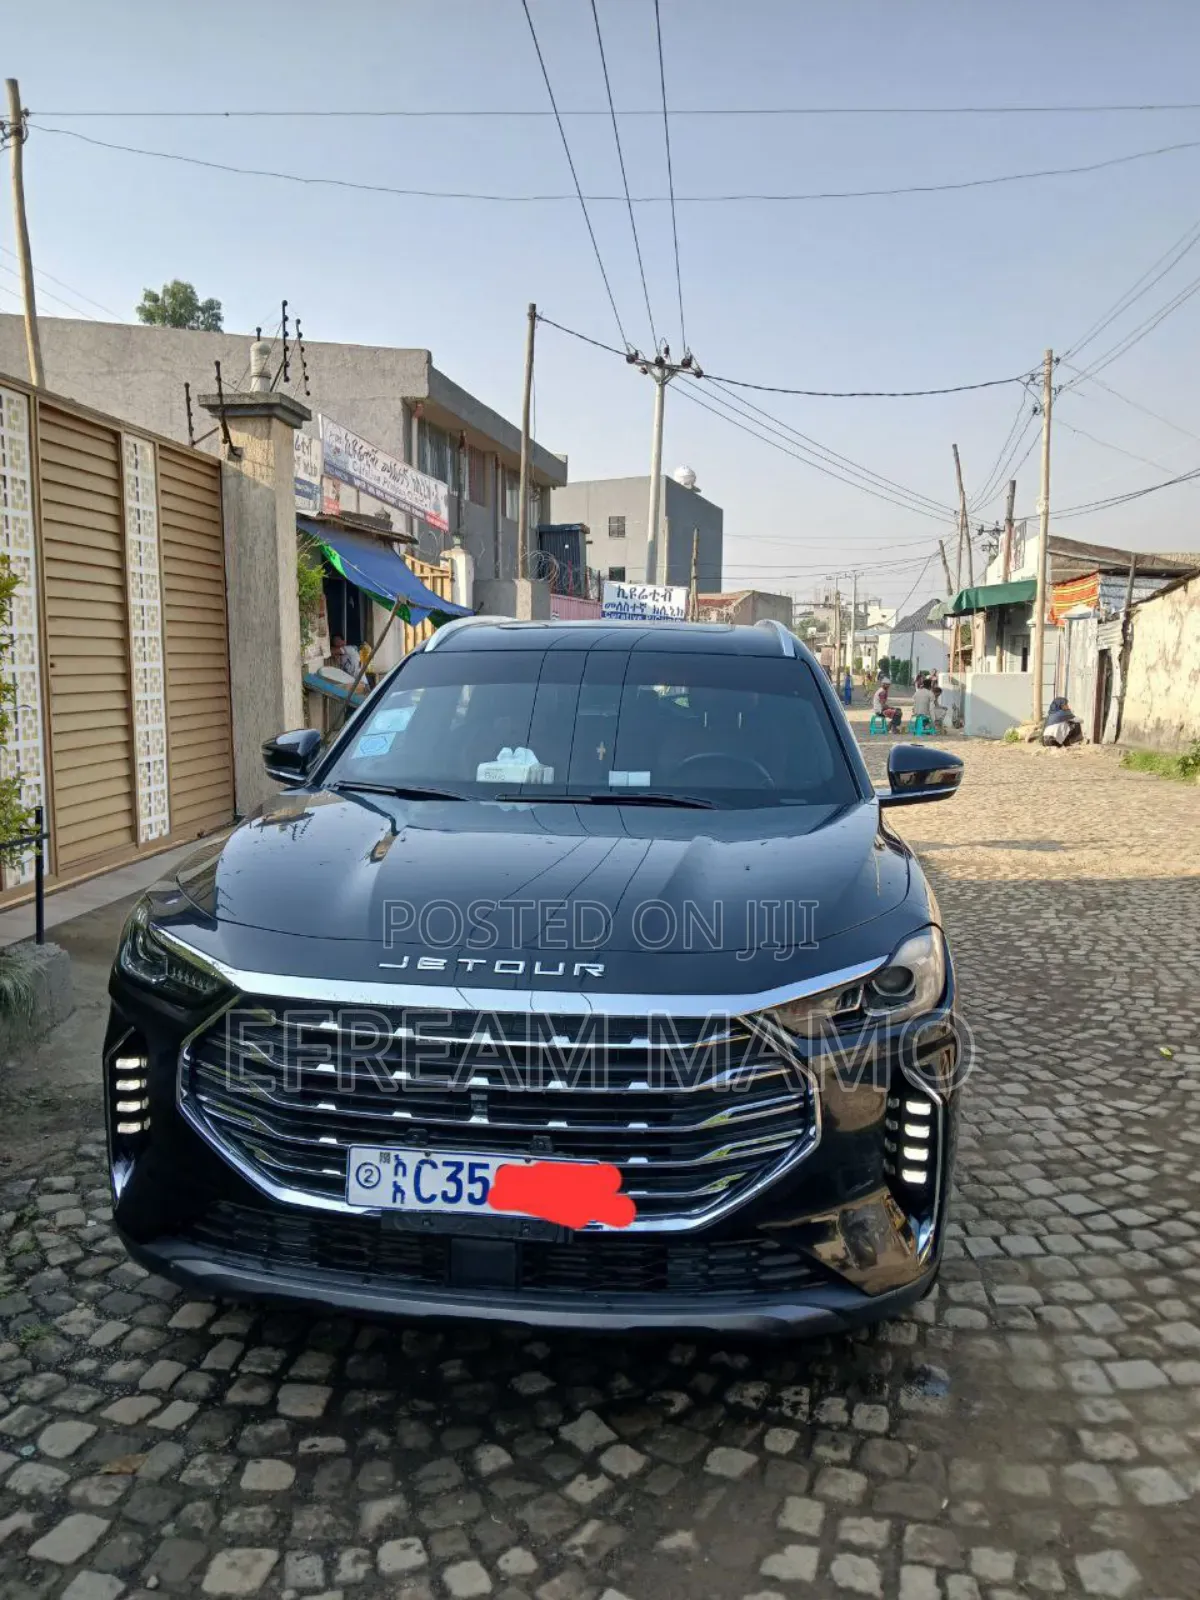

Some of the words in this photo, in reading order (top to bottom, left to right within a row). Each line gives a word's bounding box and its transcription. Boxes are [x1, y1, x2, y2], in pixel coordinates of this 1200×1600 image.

[617, 585, 674, 602] ኪዩሬቲቭ
[604, 602, 647, 613] መለስተኛ
[653, 604, 684, 617] ክሊኒክ
[378, 955, 605, 978] JETOUR
